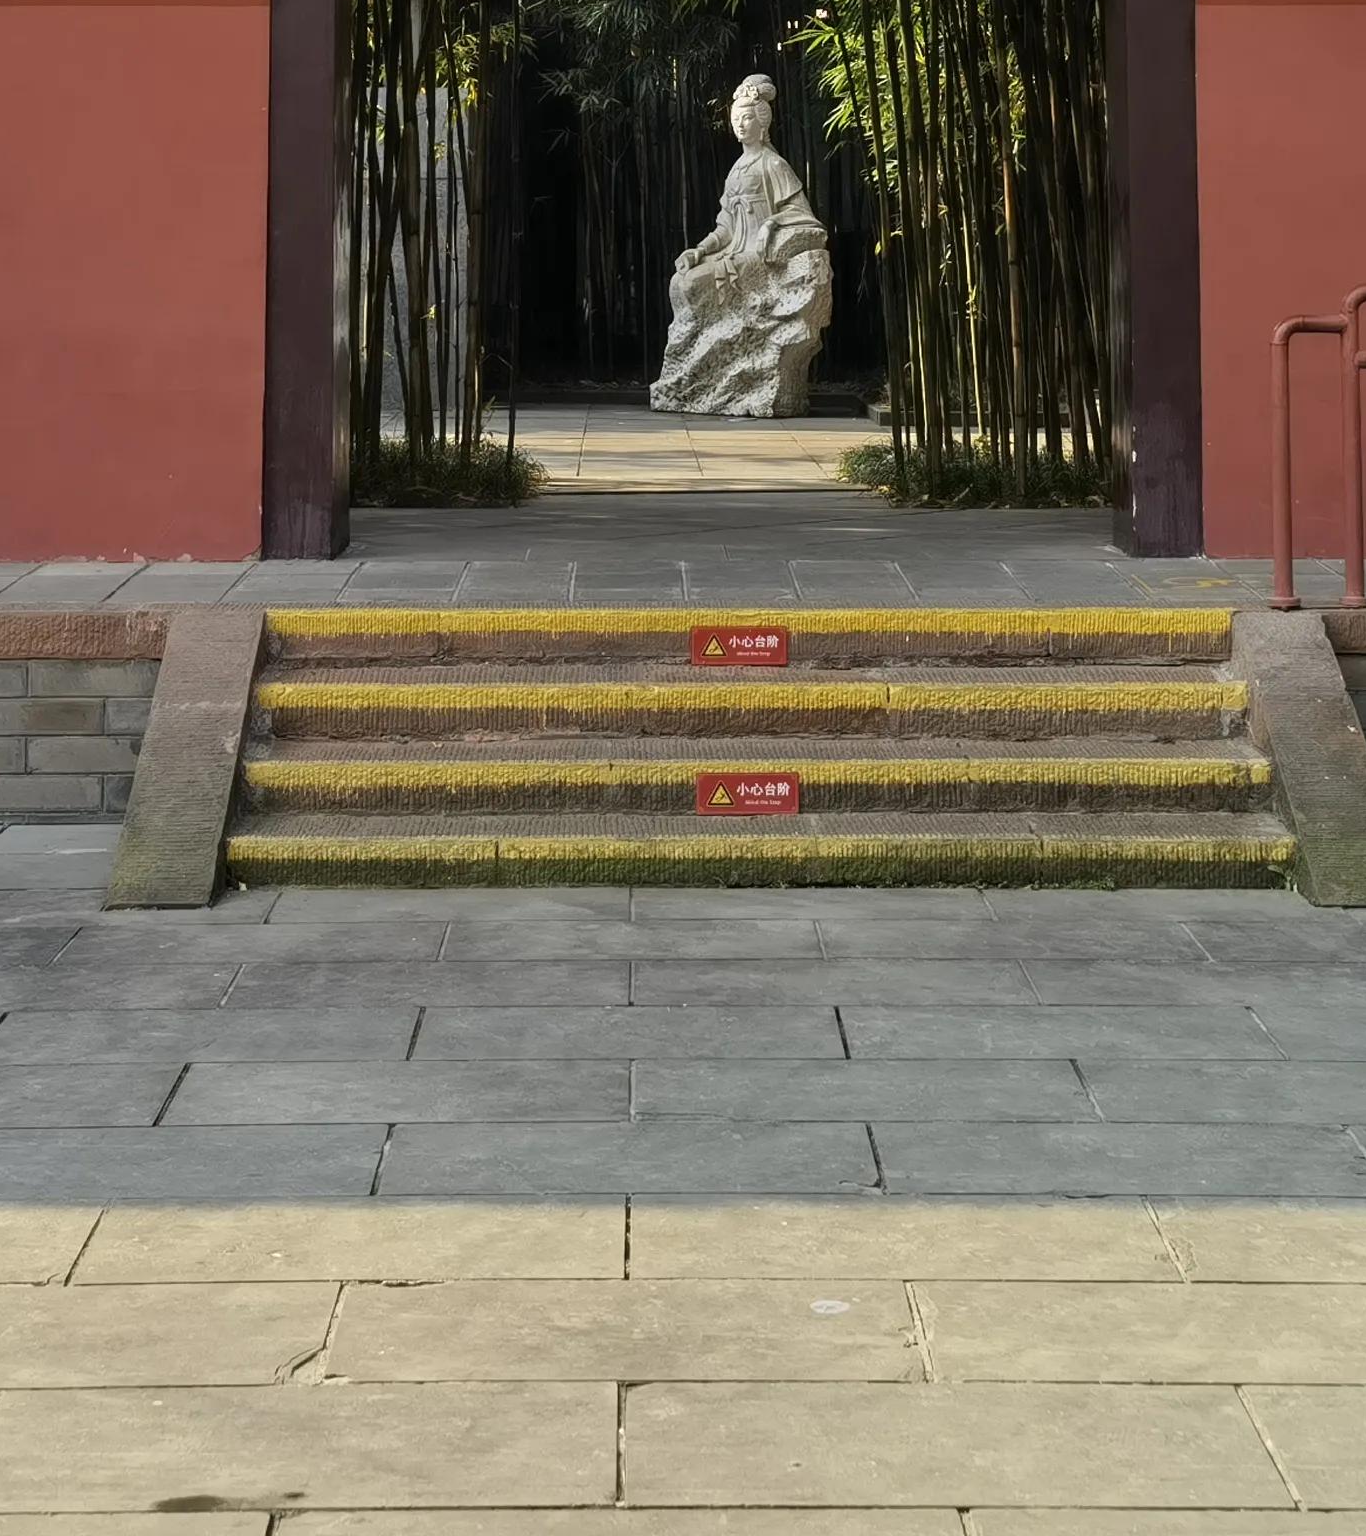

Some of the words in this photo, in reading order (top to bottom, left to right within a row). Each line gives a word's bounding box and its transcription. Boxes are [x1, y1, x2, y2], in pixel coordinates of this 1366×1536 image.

[728, 634, 779, 648] 小心台阶
[736, 781, 790, 797] 小心台阶
